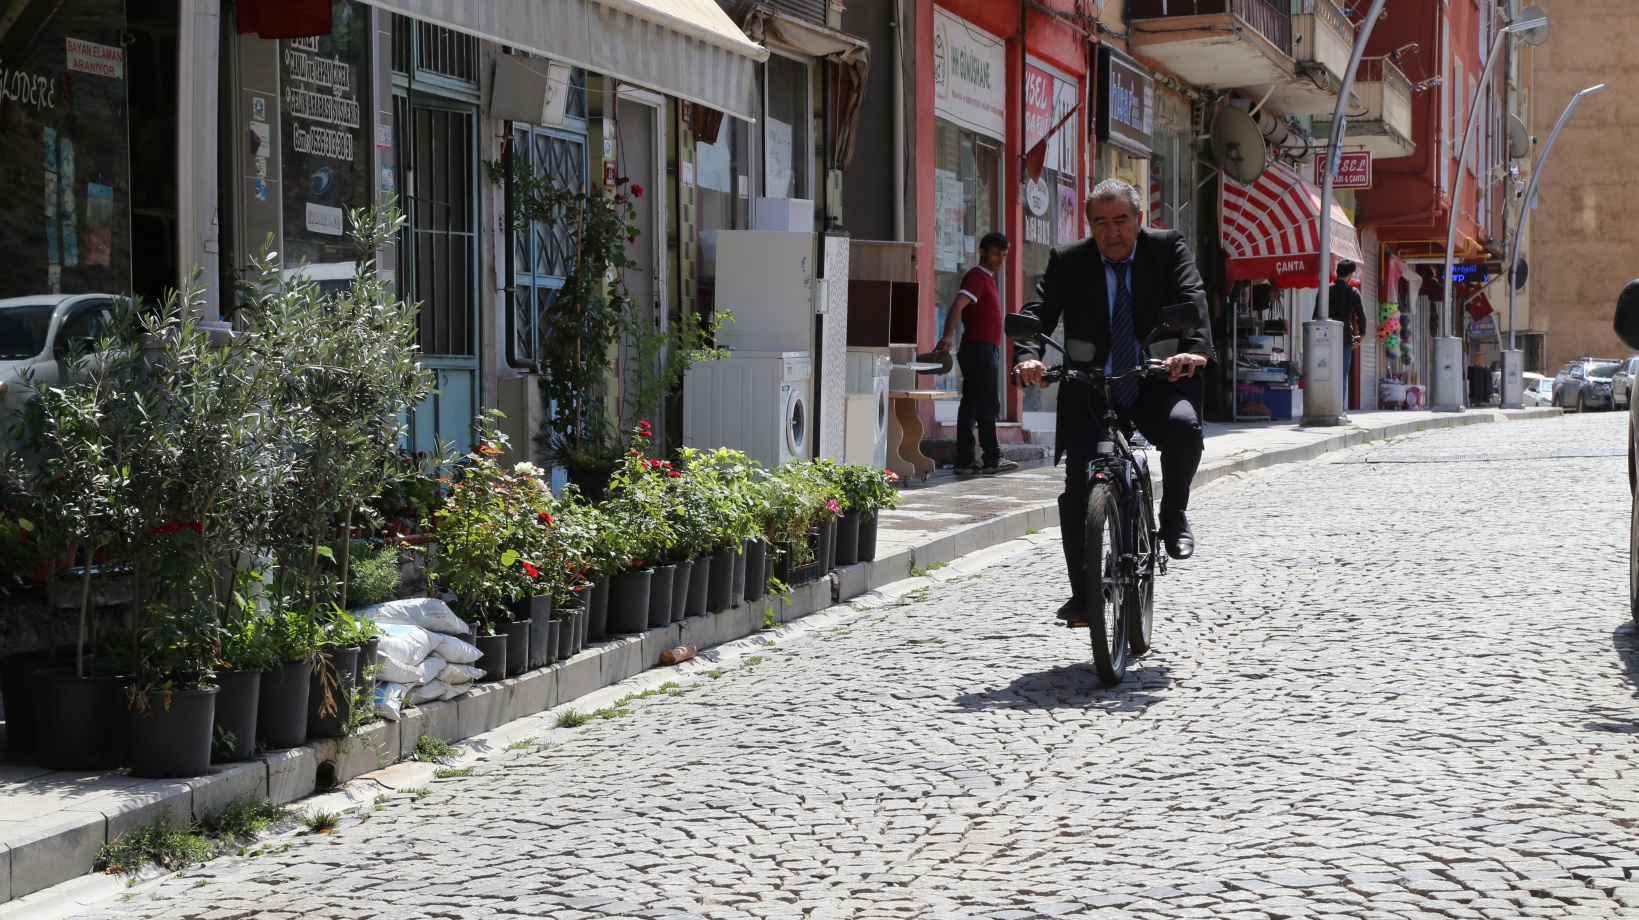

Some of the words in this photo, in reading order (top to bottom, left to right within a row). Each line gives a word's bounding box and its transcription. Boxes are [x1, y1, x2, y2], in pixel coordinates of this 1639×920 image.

[67, 40, 92, 57] BAYAN
[93, 47, 123, 62] ELAMAN
[73, 58, 115, 76] ARANIYOR
[959, 45, 991, 92] GÜMÜŞHANE
[309, 91, 333, 124] ARABASI
[1345, 175, 1349, 183] &
[1350, 175, 1366, 184] ÇANTA
[1276, 260, 1305, 275] ÇANTA
